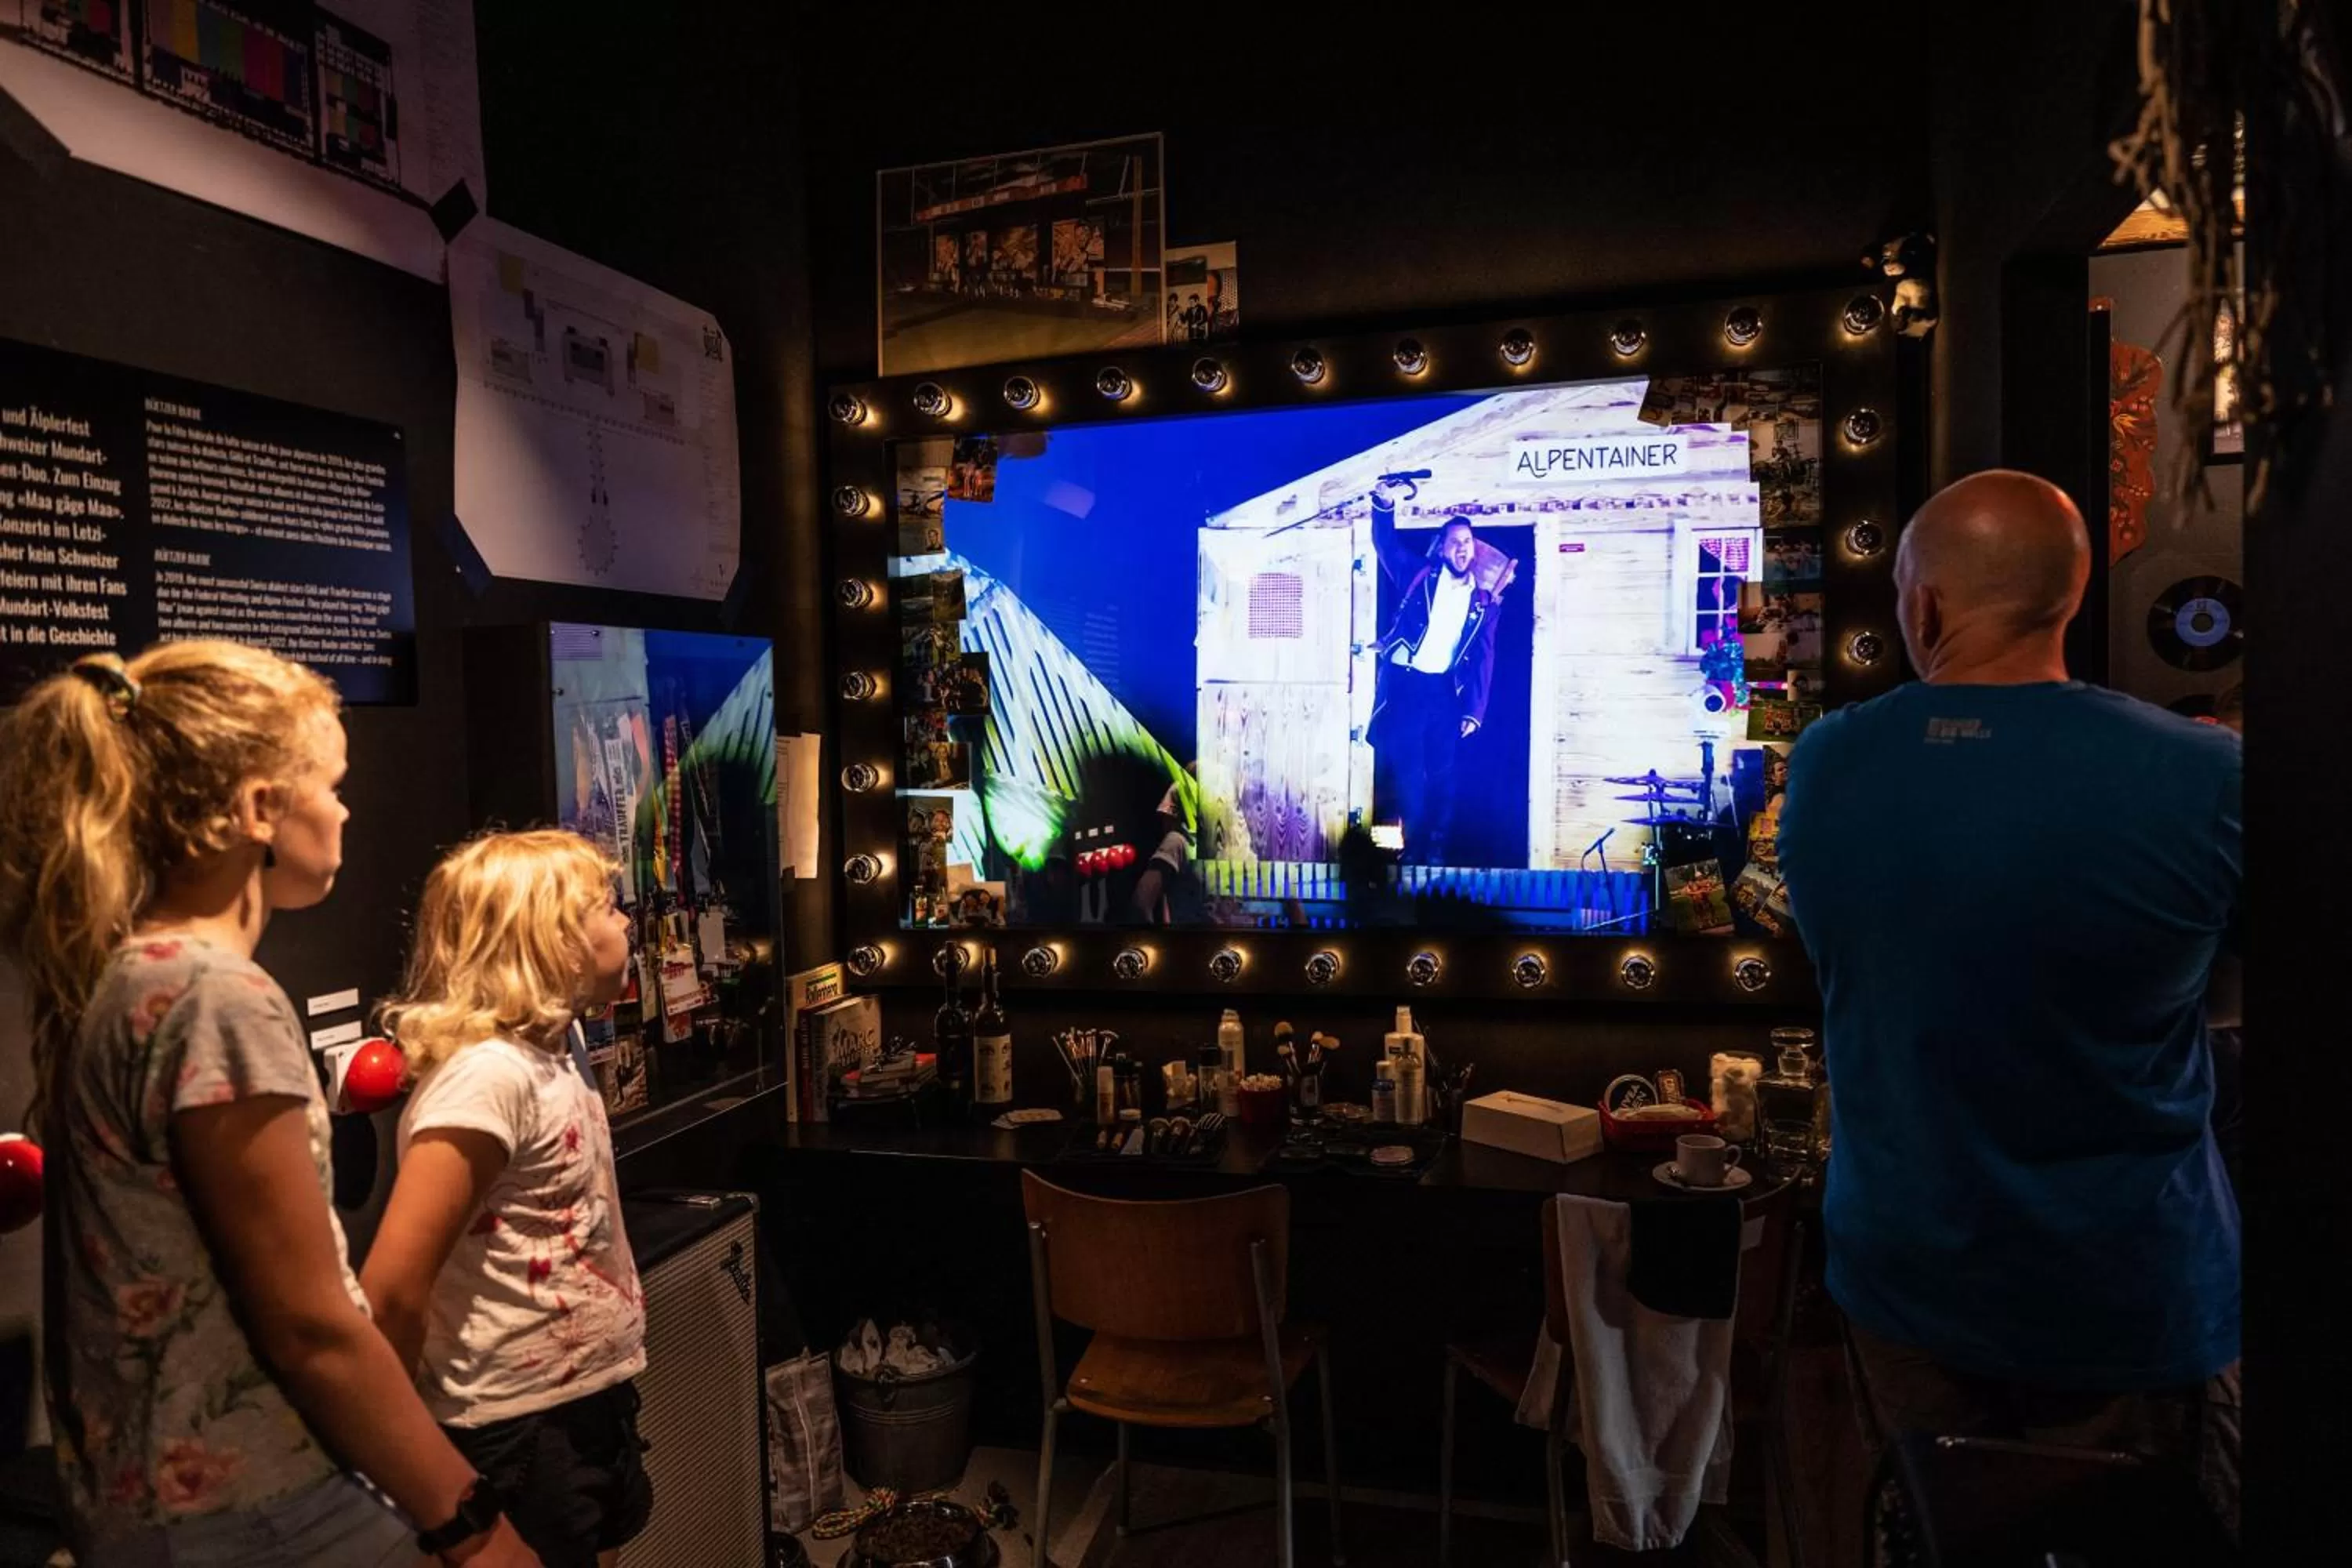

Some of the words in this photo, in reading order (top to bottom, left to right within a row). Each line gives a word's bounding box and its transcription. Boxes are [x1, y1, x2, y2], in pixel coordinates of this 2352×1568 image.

[2, 408, 27, 426] und
[29, 404, 92, 437] Älplerfest
[51, 439, 109, 466] Mundart-
[1517, 443, 1678, 478] ALPENTAINER
[53, 464, 80, 487] Zum
[82, 470, 122, 496] Einzug
[55, 493, 85, 517] gäge
[53, 520, 71, 539] im
[72, 521, 107, 543] Letzi-
[27, 543, 56, 564] kein
[57, 546, 120, 571] Schweizer
[41, 573, 64, 593] mit
[65, 574, 98, 594] ihren
[99, 575, 128, 596] Fans
[10, 623, 24, 644] in
[26, 624, 46, 645] die
[49, 625, 118, 647] Geschichte
[615, 789, 630, 844] TRAUFFER
